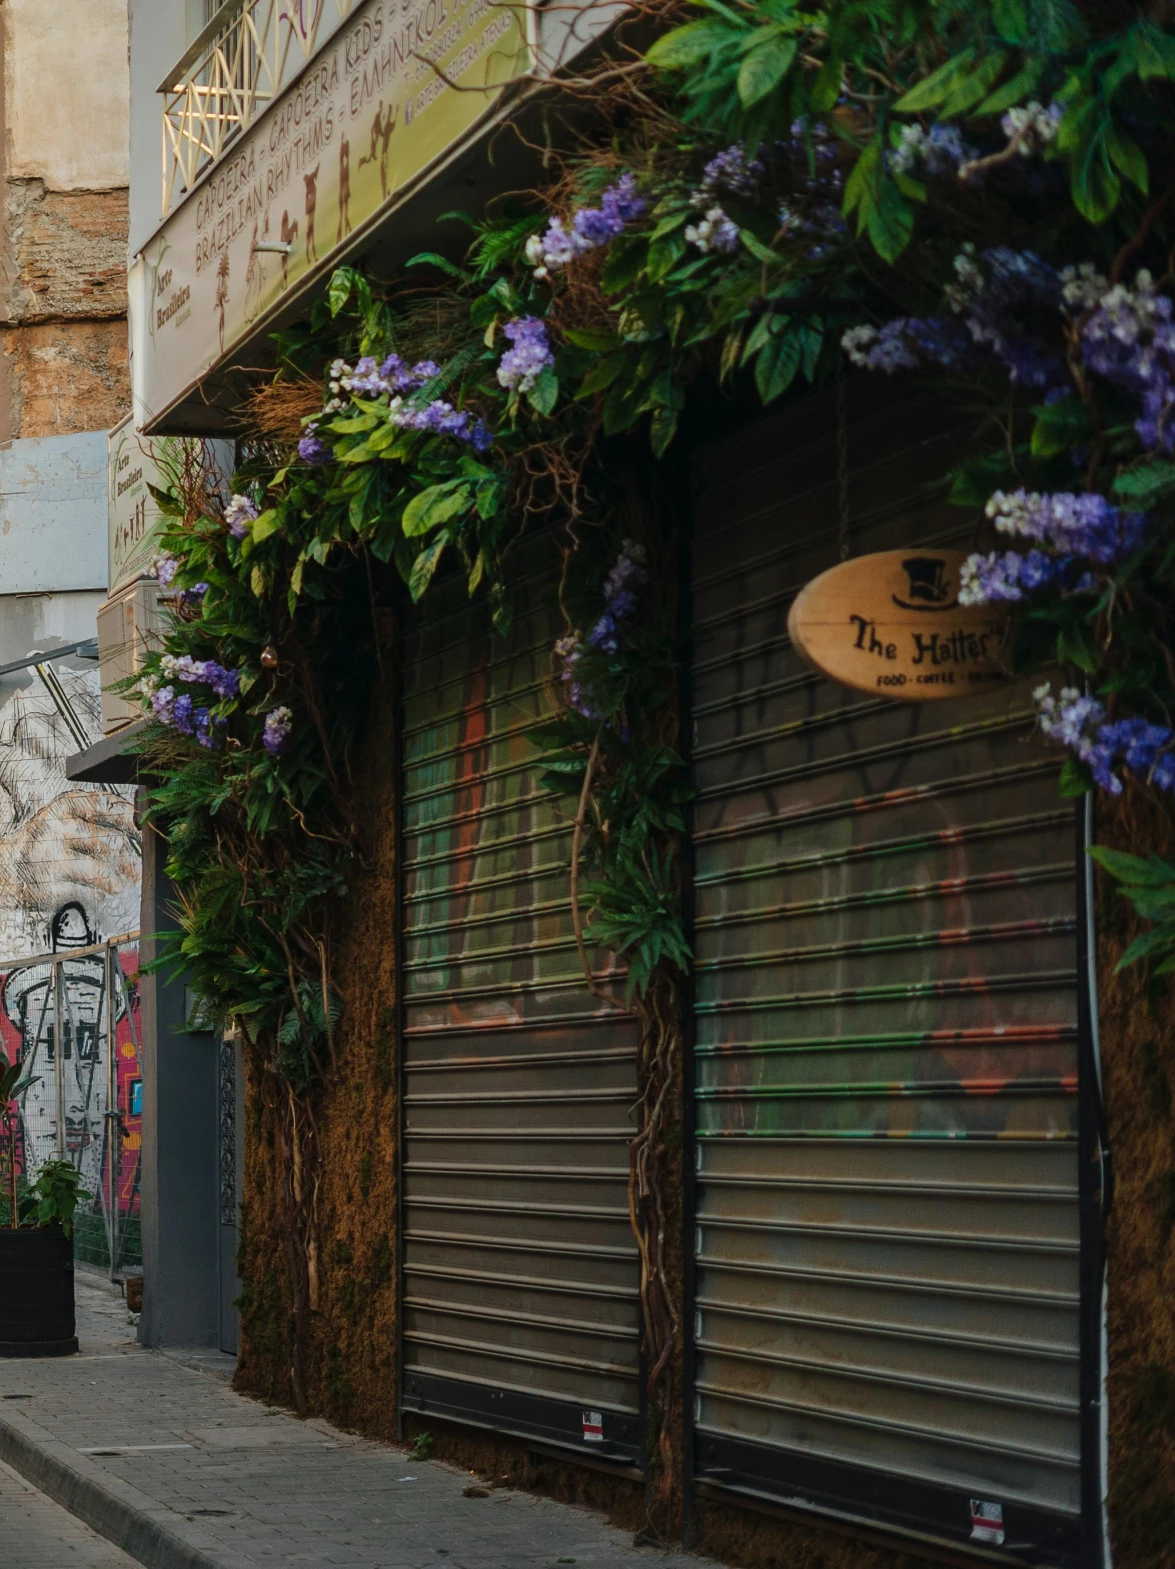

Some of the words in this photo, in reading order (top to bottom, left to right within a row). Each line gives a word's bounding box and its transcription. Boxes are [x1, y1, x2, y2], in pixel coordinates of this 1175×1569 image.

[416, 82, 433, 110] ARTE
[434, 42, 478, 96] BRSILEIRA
[480, 12, 511, 50] ATENAS
[196, 143, 256, 231] CAPOEIRA
[269, 52, 338, 154] CAPOEIRA
[345, 5, 383, 76] KIDS
[195, 176, 263, 274] BRAZILIAN
[267, 105, 333, 197] RHYTHMS
[158, 268, 173, 297] Arte
[157, 284, 190, 330] Brasileira
[117, 453, 130, 474] Arte
[117, 467, 143, 497] Brasileira
[849, 614, 897, 660] The
[877, 673, 907, 687] FOOD
